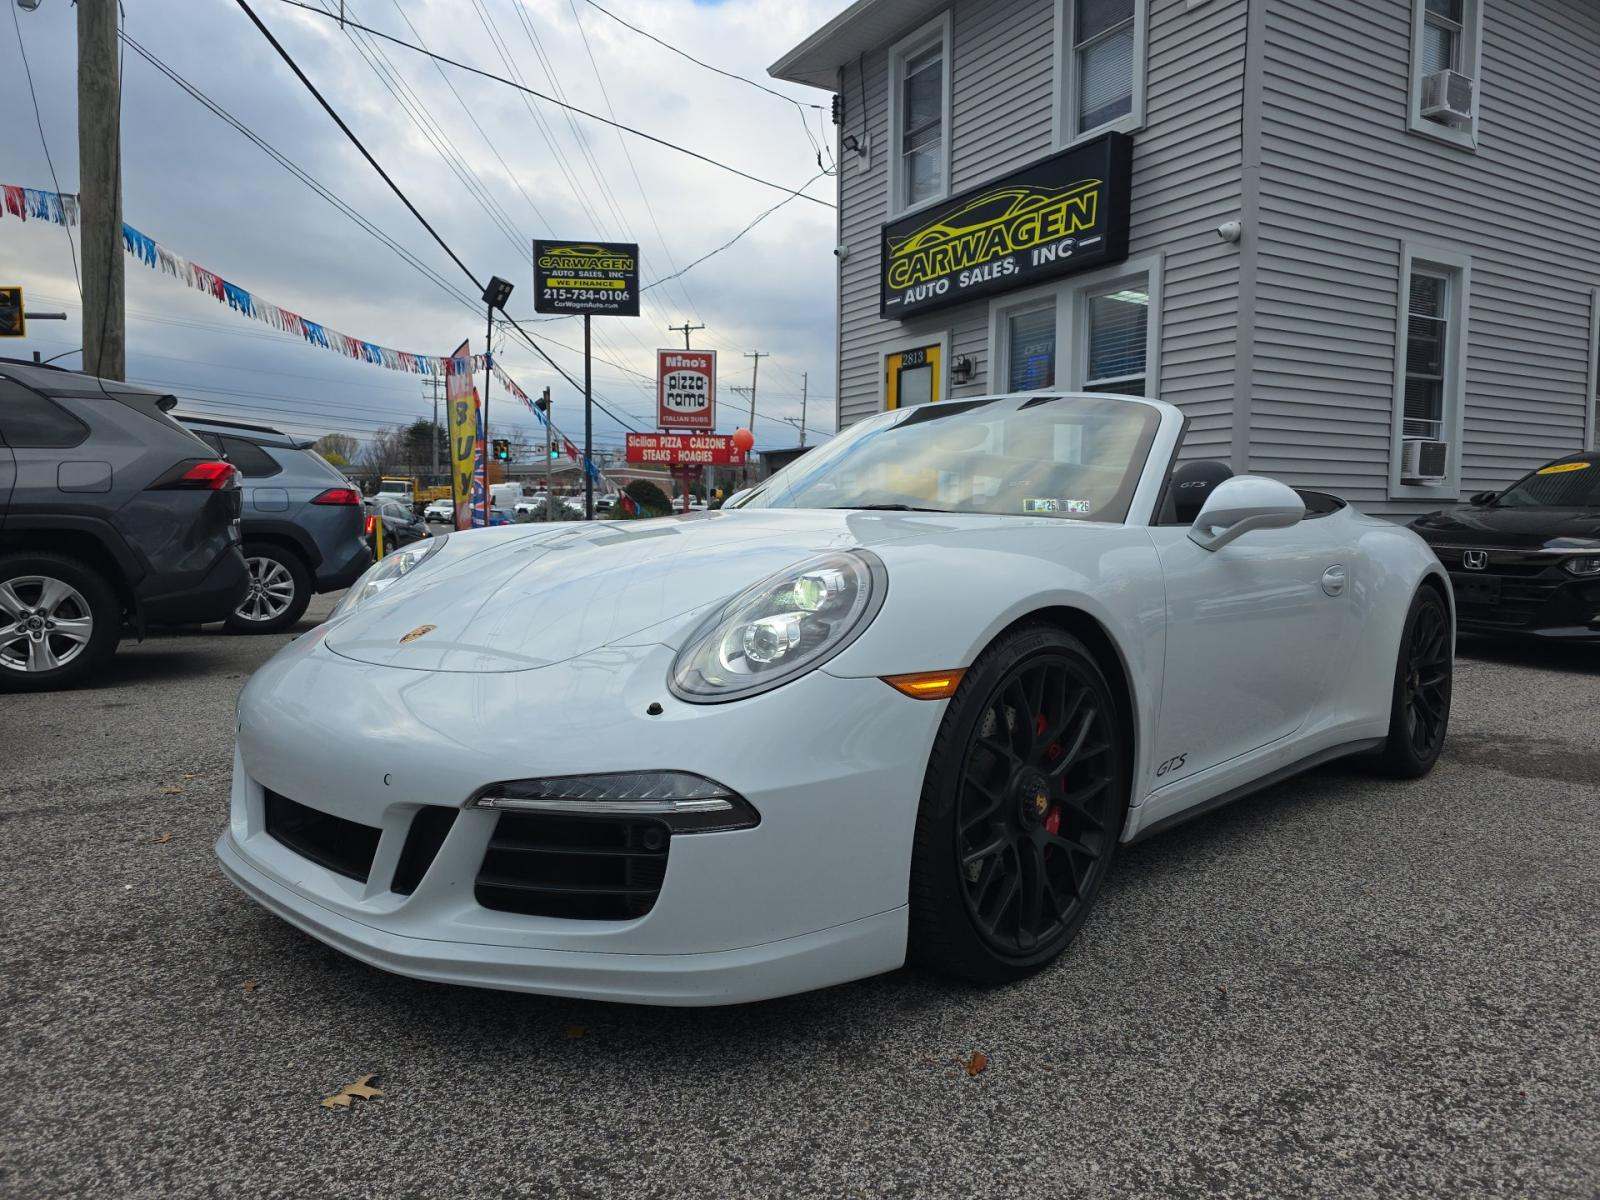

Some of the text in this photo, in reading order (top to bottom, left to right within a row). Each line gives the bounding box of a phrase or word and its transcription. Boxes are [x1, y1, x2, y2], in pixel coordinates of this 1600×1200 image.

[888, 190, 1098, 290] CARWAGEN
[538, 257, 633, 271] CARWAGEN
[578, 270, 605, 278] SALES,
[904, 239, 1074, 305] AUTO SALES, INC
[543, 289, 630, 300] 215-734-0106
[665, 356, 707, 368] Nino's
[902, 350, 924, 366] 2813
[667, 391, 706, 407] rama
[663, 415, 690, 423] ITALIAN
[628, 436, 657, 448] Sicilian
[660, 436, 682, 448] PIZZA
[689, 437, 726, 450] CALZONE
[642, 449, 713, 461] STEAKS HOAGIES
[1156, 752, 1188, 778] GTS
